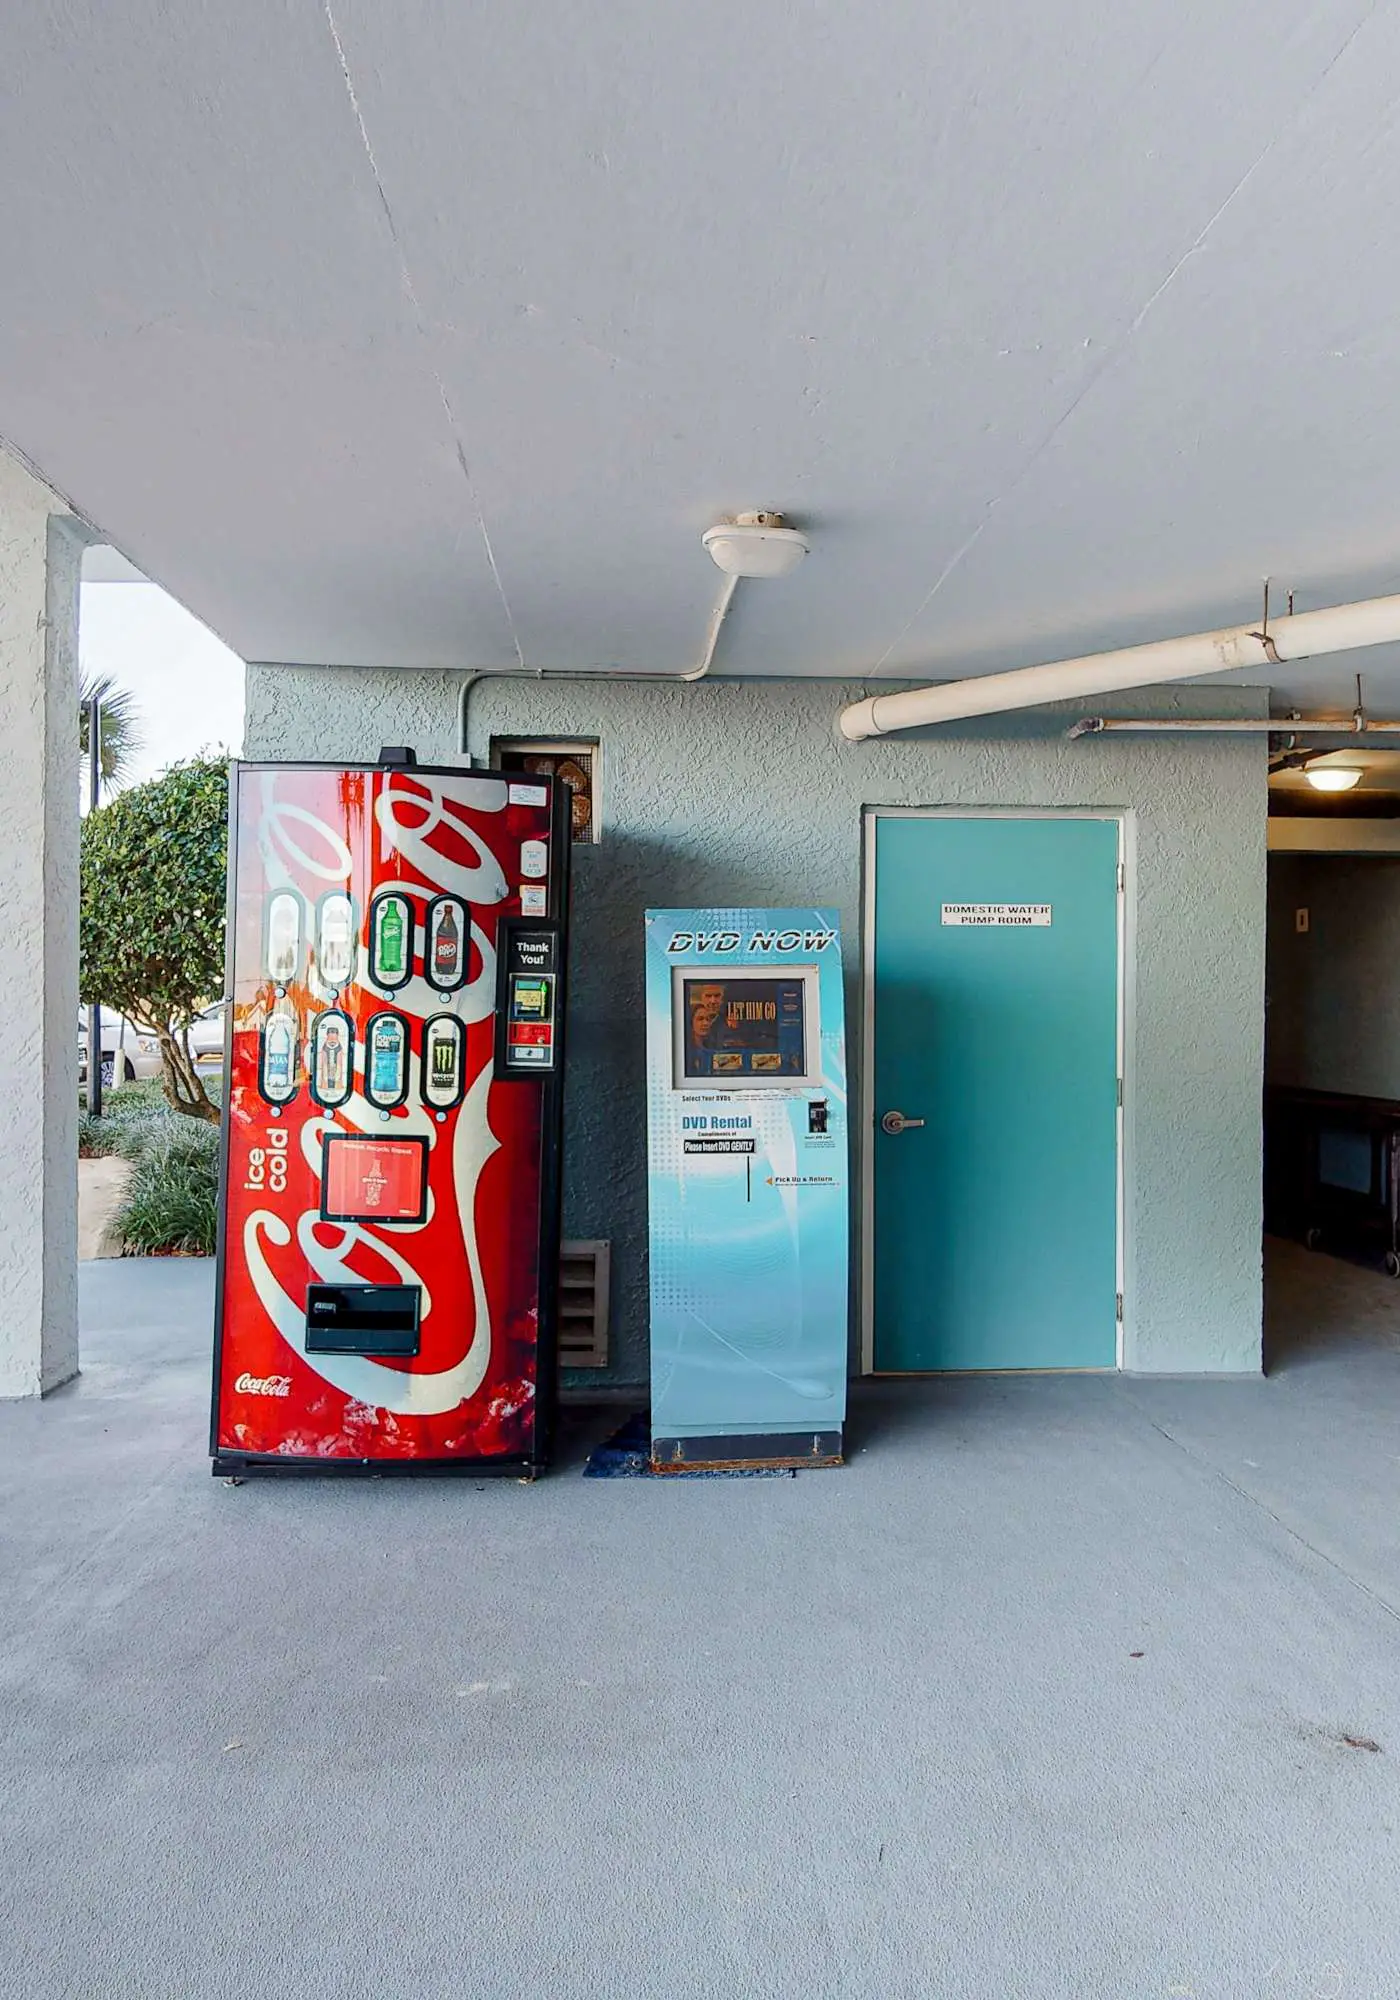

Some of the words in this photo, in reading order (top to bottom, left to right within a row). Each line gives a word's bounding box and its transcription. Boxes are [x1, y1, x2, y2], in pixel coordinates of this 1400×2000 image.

[944, 906, 1005, 914] DOMESTIC
[1008, 906, 1048, 914] WATER
[961, 916, 995, 924] PUMP
[998, 916, 1032, 924] ROOM
[516, 942, 549, 953] Thank
[667, 930, 741, 953] DVD
[747, 929, 837, 953] NOW
[520, 954, 544, 965] You!
[727, 1001, 745, 1020] LET
[746, 1001, 763, 1020] HIM
[764, 1001, 776, 1020] GO
[682, 1116, 707, 1129] DVD
[711, 1115, 752, 1129] Rental
[684, 1141, 702, 1152] Please
[702, 1141, 718, 1152] Insert
[718, 1141, 730, 1151] DVD
[730, 1141, 753, 1151] GENTLY
[266, 1127, 289, 1193] cold
[243, 1147, 266, 1191] ice
[234, 1372, 294, 1397] Coca-Cola
